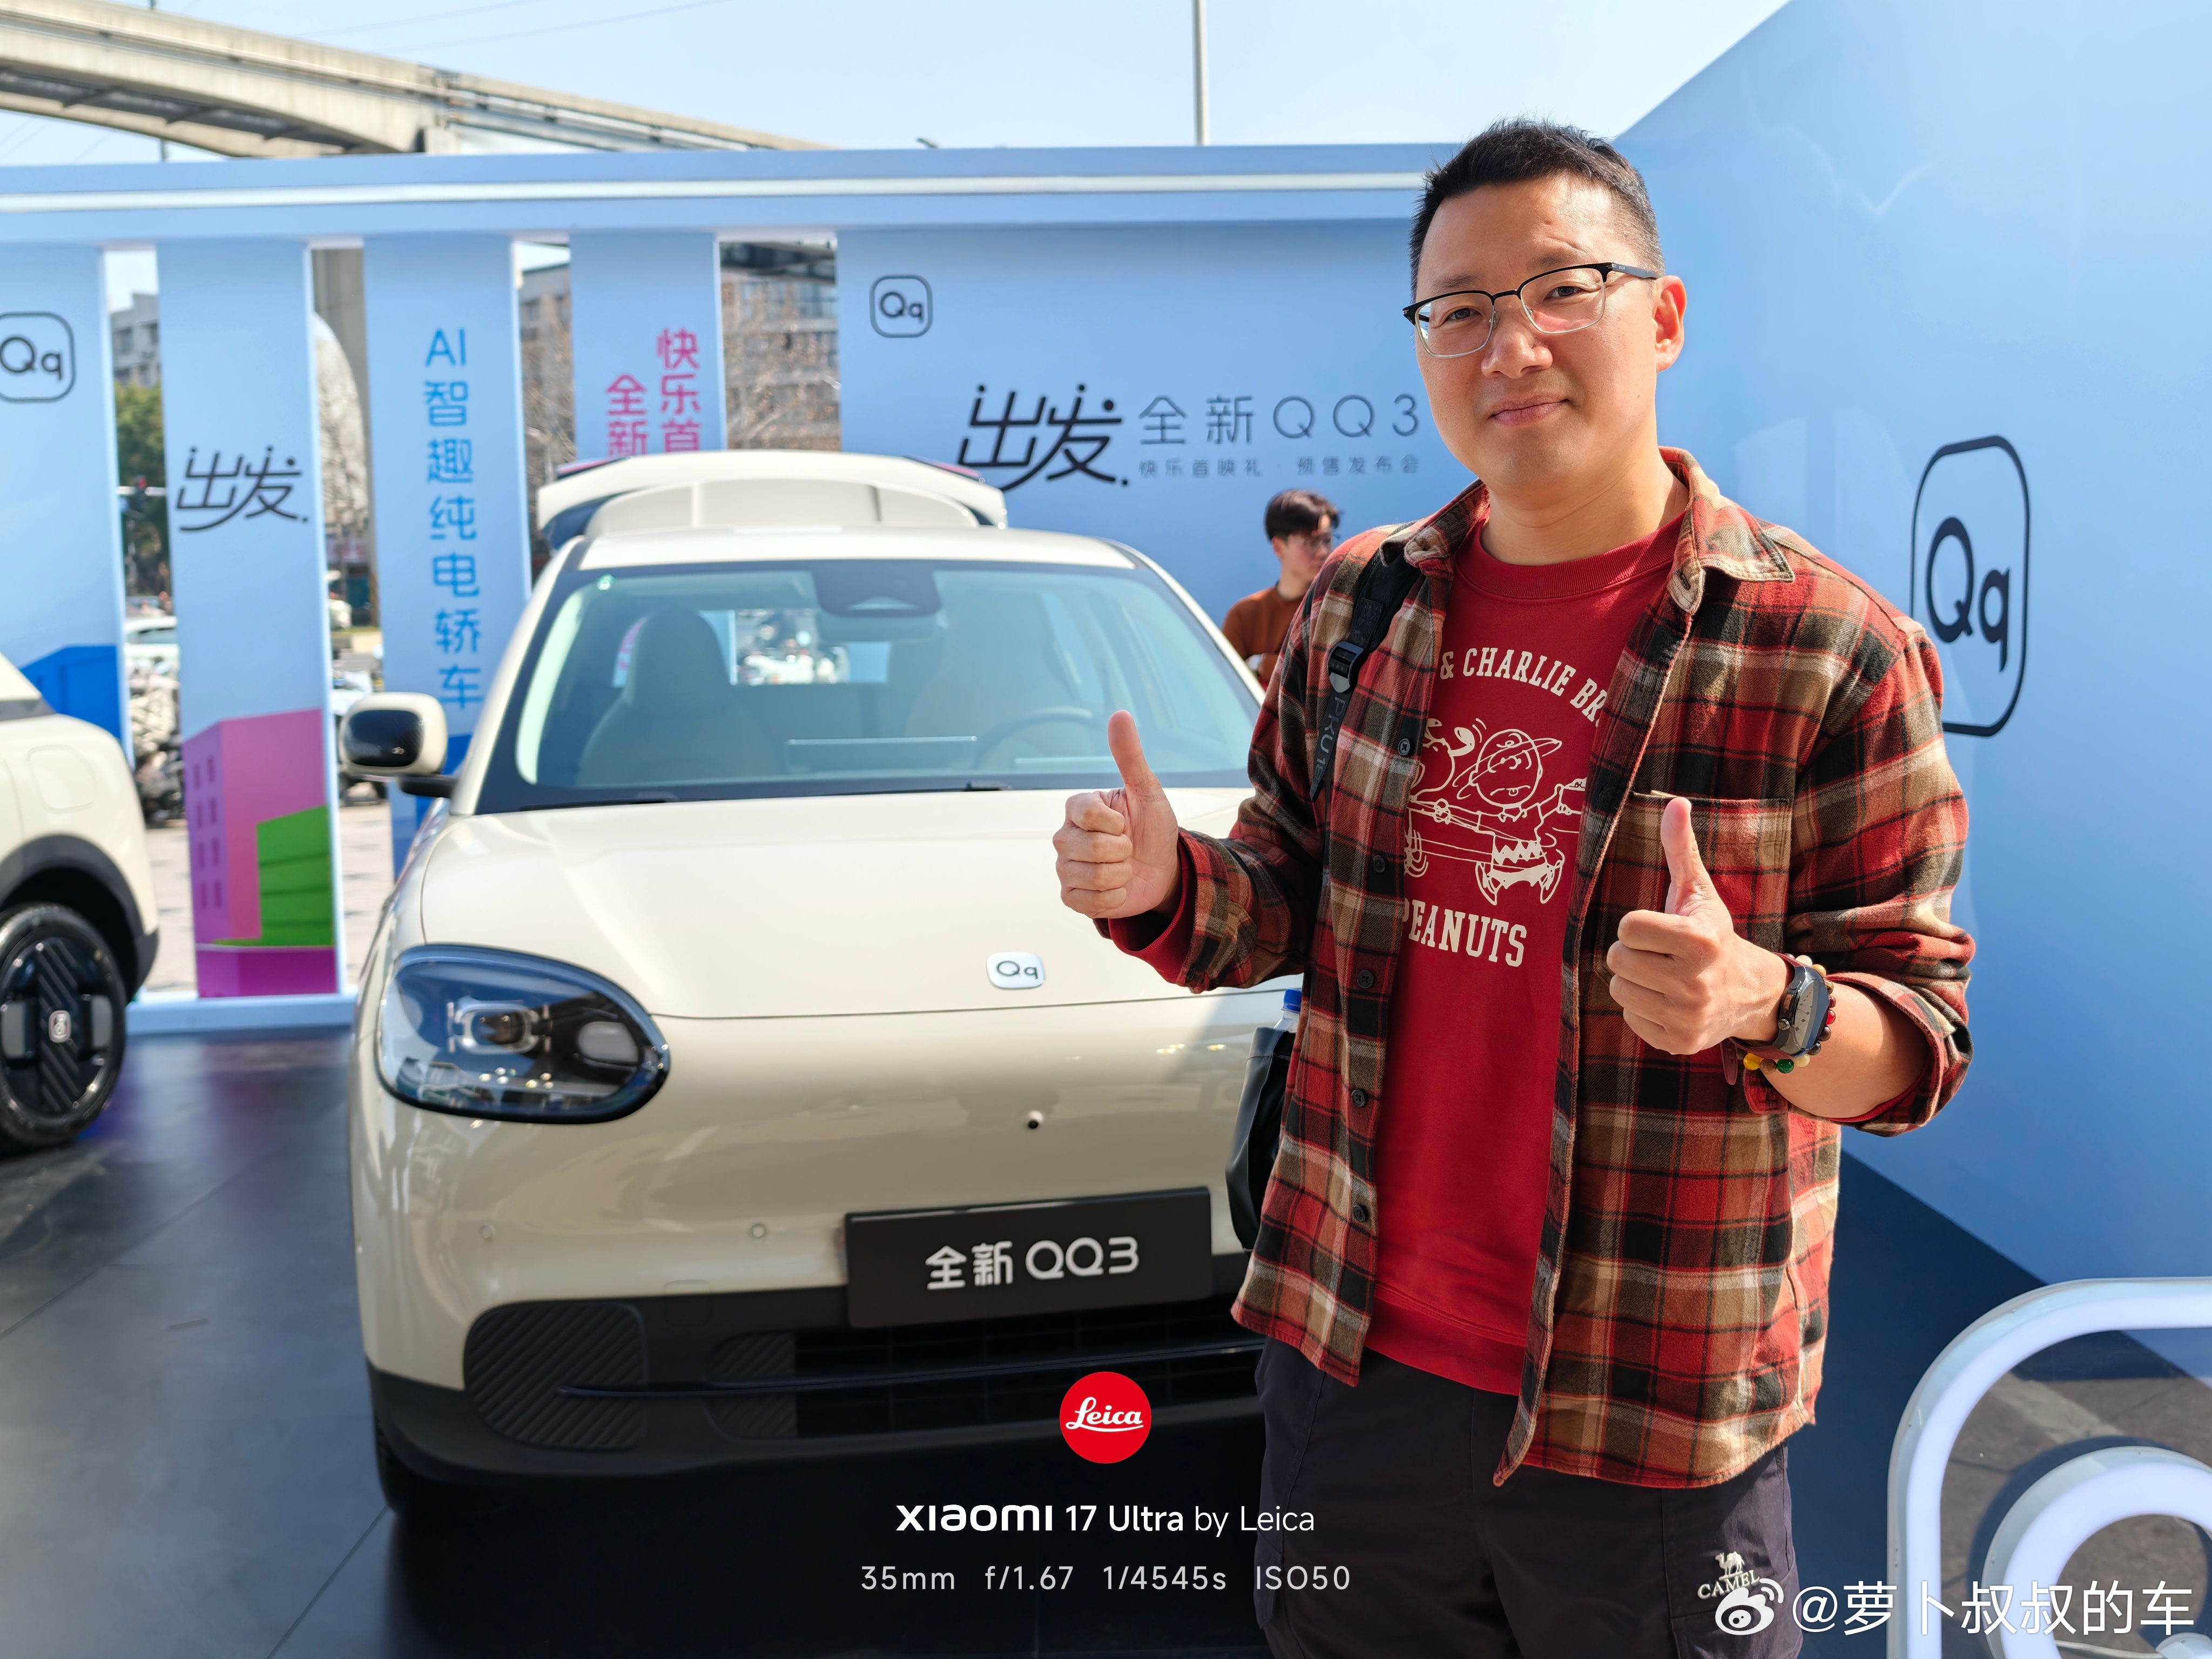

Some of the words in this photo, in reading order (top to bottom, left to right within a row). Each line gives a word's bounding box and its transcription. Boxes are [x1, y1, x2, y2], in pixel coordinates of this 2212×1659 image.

[878, 291, 925, 323] Qq
[1925, 516, 2011, 673] Qq
[1440, 651, 1454, 680] &
[1463, 647, 1576, 697] CHARLIE
[1569, 677, 1608, 727] BR
[995, 960, 1039, 981] Qq
[1697, 1569, 1760, 1600] CAMEL
